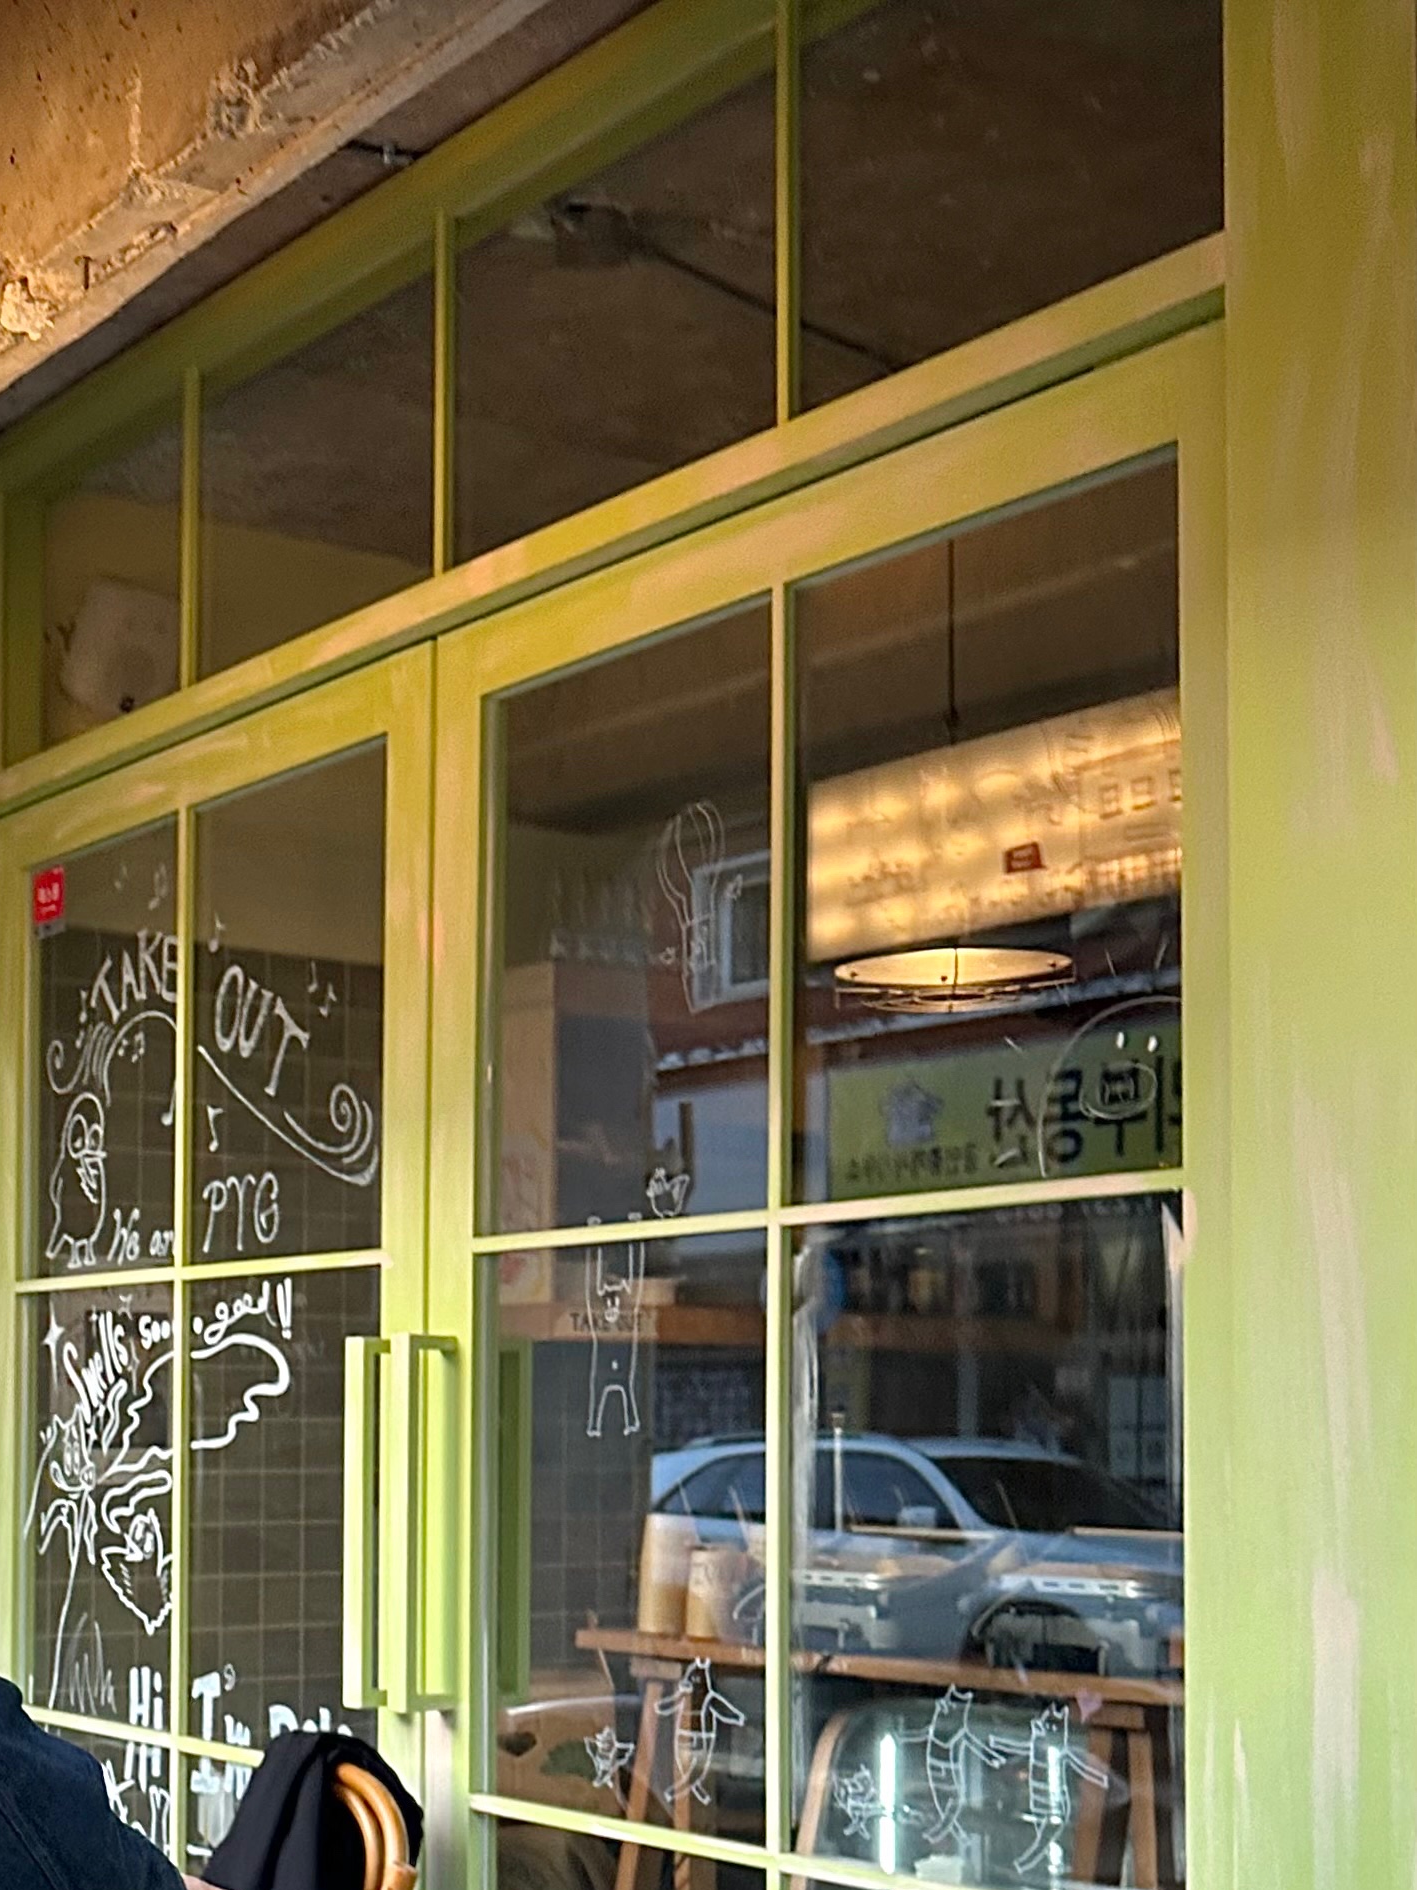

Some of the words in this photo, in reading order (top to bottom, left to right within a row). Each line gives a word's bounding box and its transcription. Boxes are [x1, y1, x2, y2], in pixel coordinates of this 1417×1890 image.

[90, 928, 180, 1025] TAKE
[214, 964, 311, 1098] OUT
[107, 1207, 140, 1266] We
[202, 1171, 280, 1254] PYG
[63, 1310, 129, 1425] Smells
[123, 1666, 164, 1794] Hi
